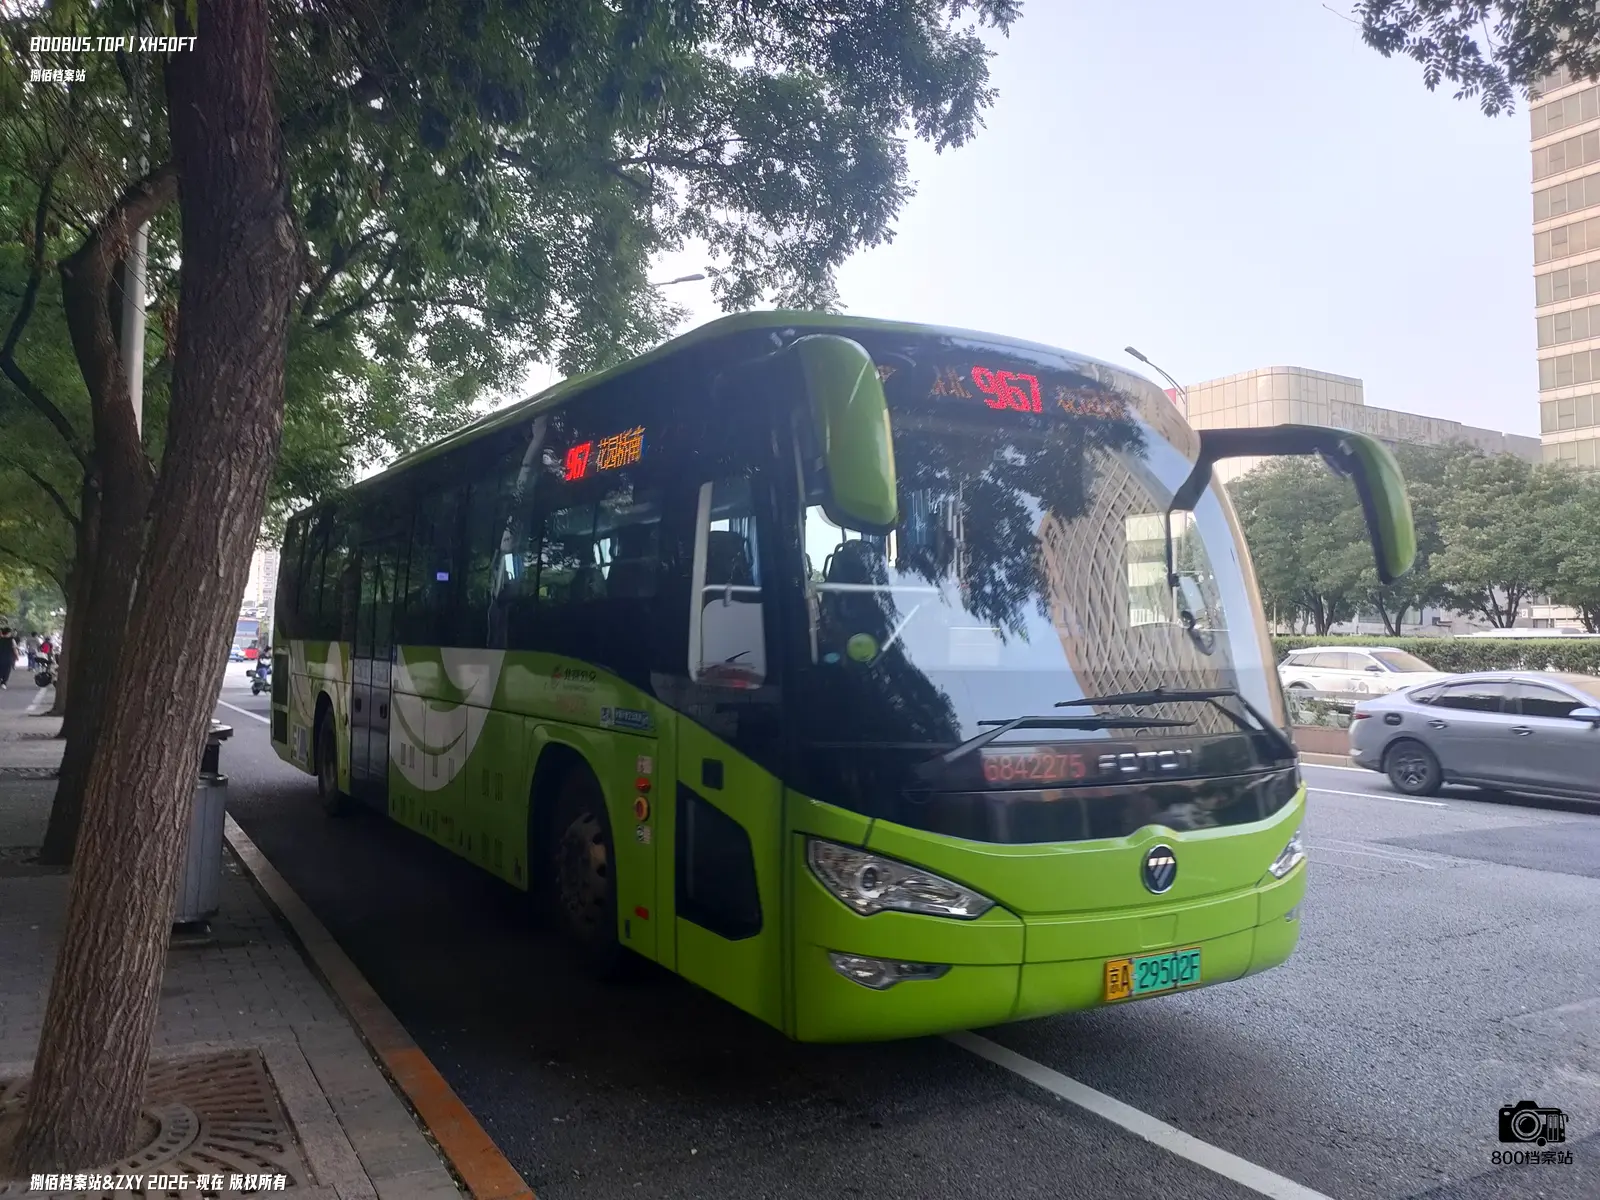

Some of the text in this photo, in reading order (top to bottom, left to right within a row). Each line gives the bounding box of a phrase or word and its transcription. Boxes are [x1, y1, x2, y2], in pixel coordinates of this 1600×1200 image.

[970, 364, 1044, 414] 967
[565, 425, 646, 481] 967 花园桥南
[983, 753, 1087, 781] 6842275
